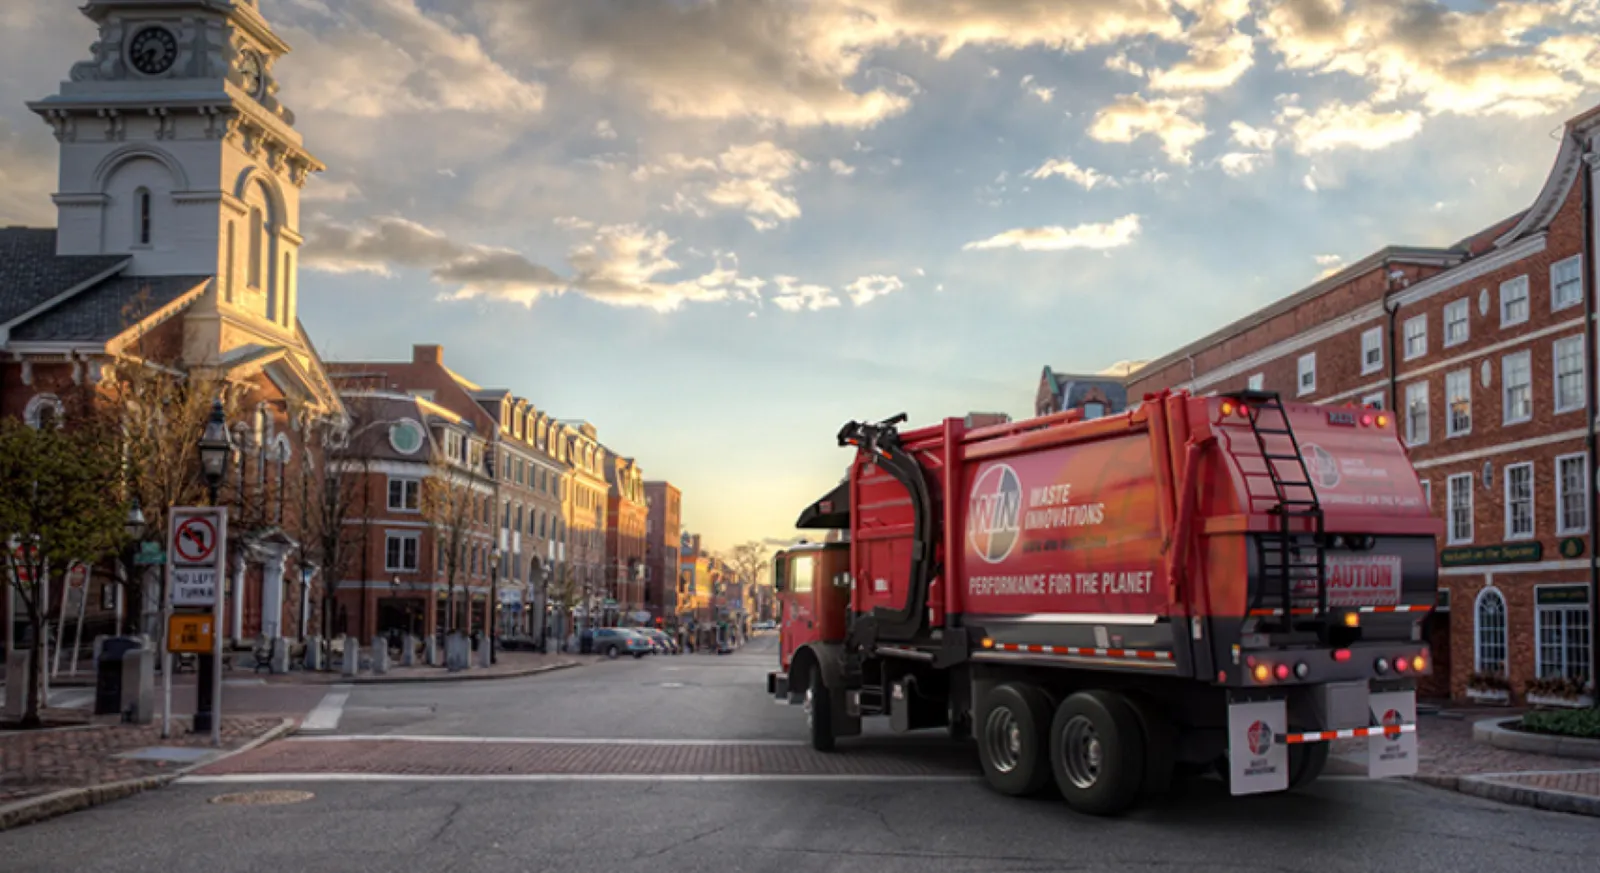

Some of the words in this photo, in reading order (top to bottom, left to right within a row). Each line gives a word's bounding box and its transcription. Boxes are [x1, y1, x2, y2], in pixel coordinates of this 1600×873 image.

[1030, 484, 1071, 507] WASTE
[1025, 503, 1105, 530] INNOVATIONS
[175, 572, 190, 584] NO
[192, 571, 216, 584] LEFT
[969, 573, 1046, 596] PERFORMANCE
[1048, 573, 1072, 595] FOR
[1075, 572, 1098, 594] THE
[1102, 571, 1153, 594] PLANET
